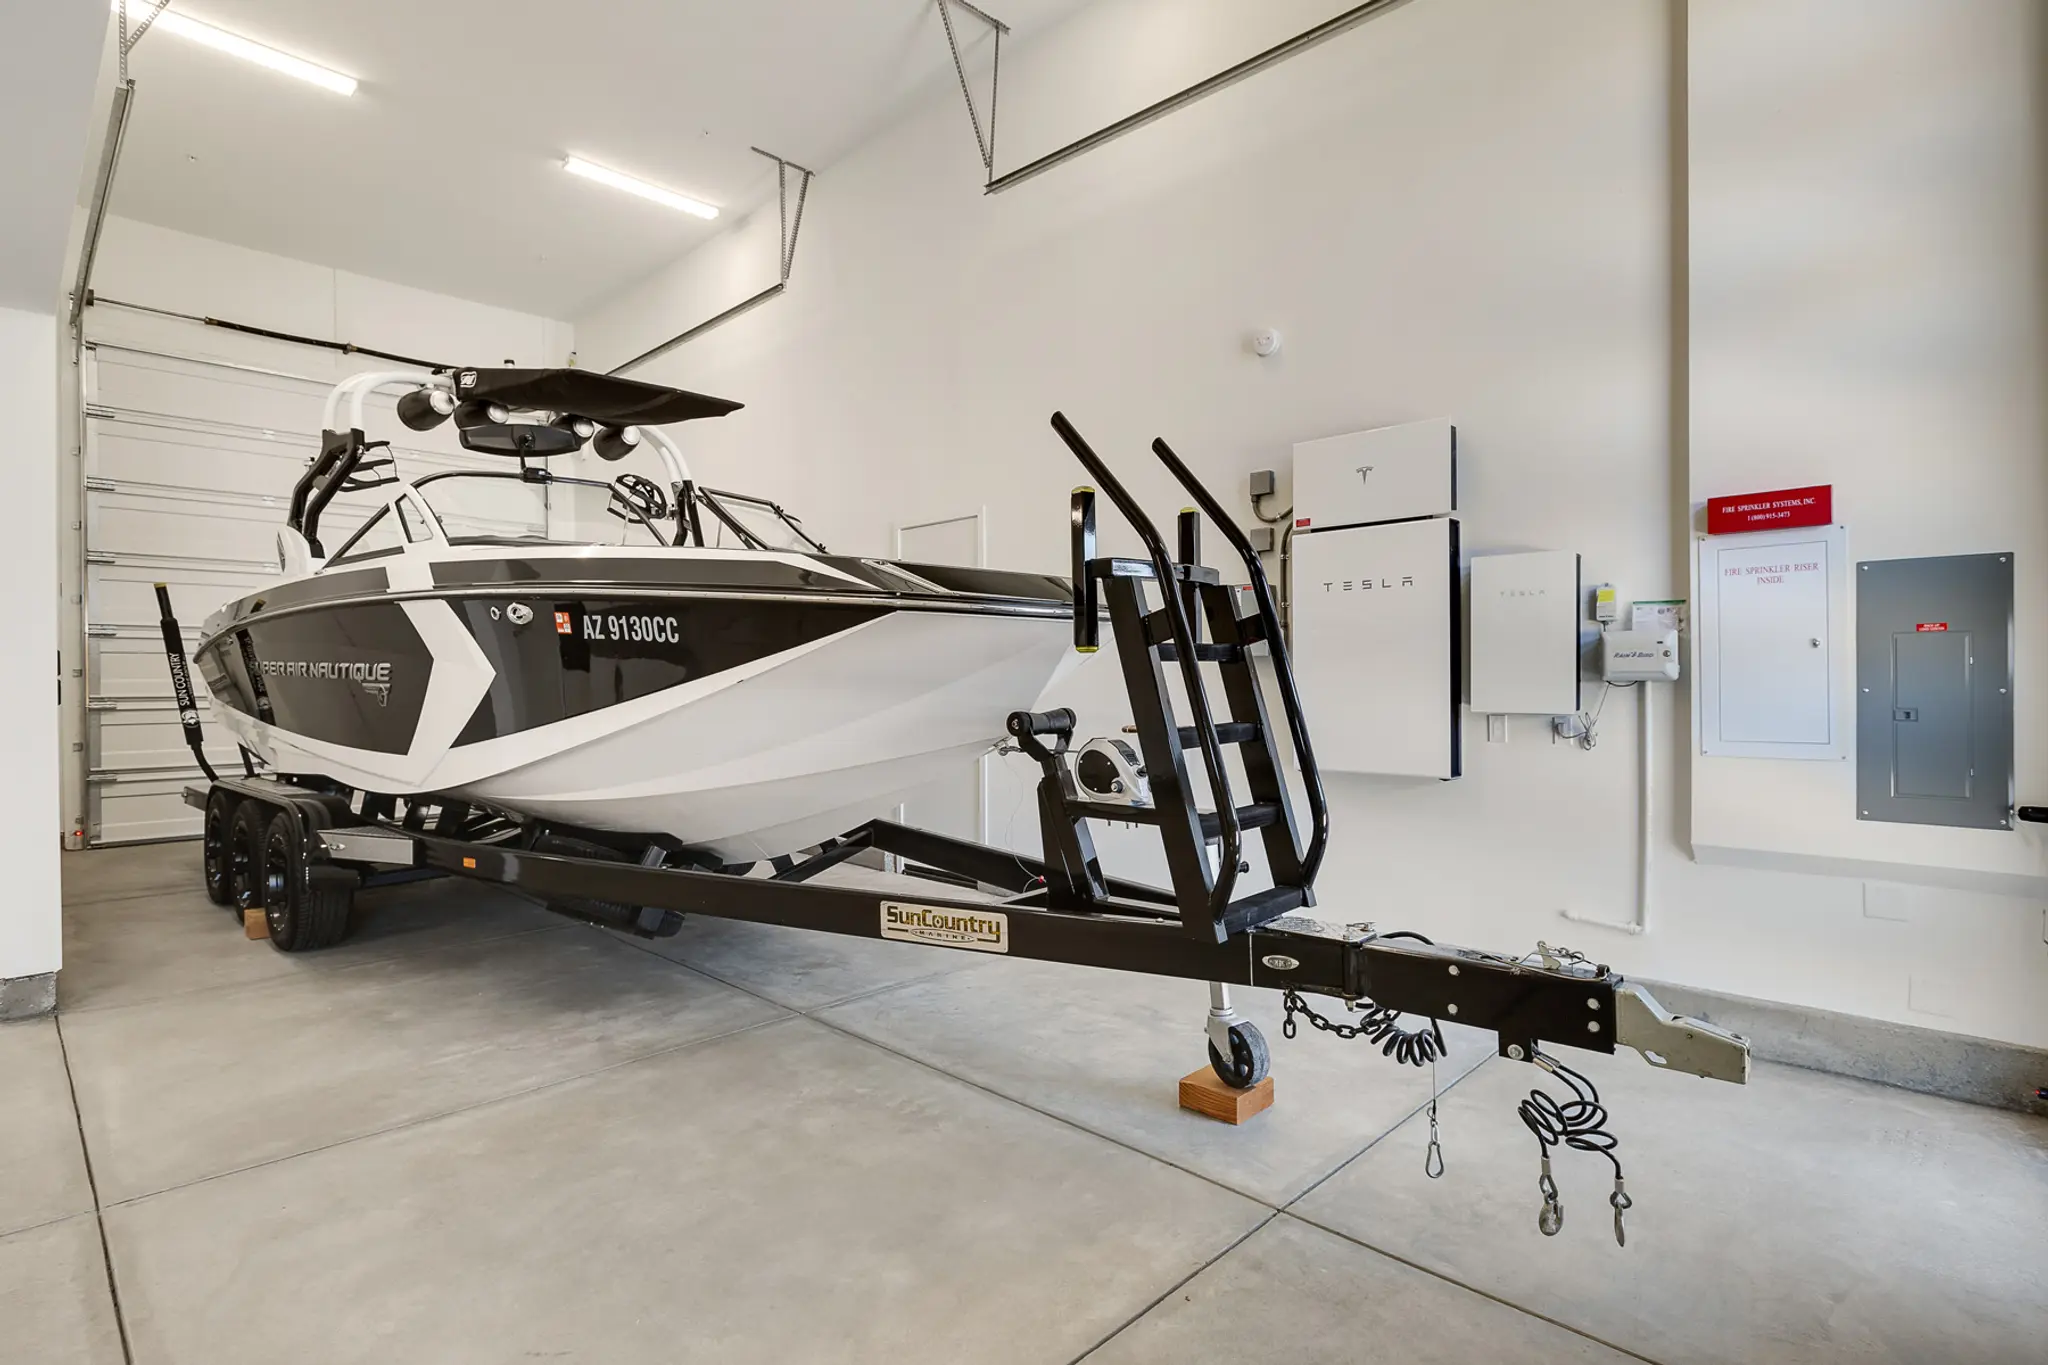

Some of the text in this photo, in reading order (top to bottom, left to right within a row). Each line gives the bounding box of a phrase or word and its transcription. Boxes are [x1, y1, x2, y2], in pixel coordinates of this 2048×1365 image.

[1738, 502, 1771, 512] SPRINKLER
[1724, 562, 1819, 576] FIRE SPRINKLER RISER
[1323, 576, 1413, 592] TESLA
[1757, 575, 1784, 585] INSIDE
[583, 615, 605, 639] AZ
[608, 615, 679, 643] 9130CC
[168, 652, 186, 690] COUNTRY
[287, 661, 307, 677] AIR
[309, 661, 392, 683] NAUTIQUE
[175, 690, 190, 707] SUN
